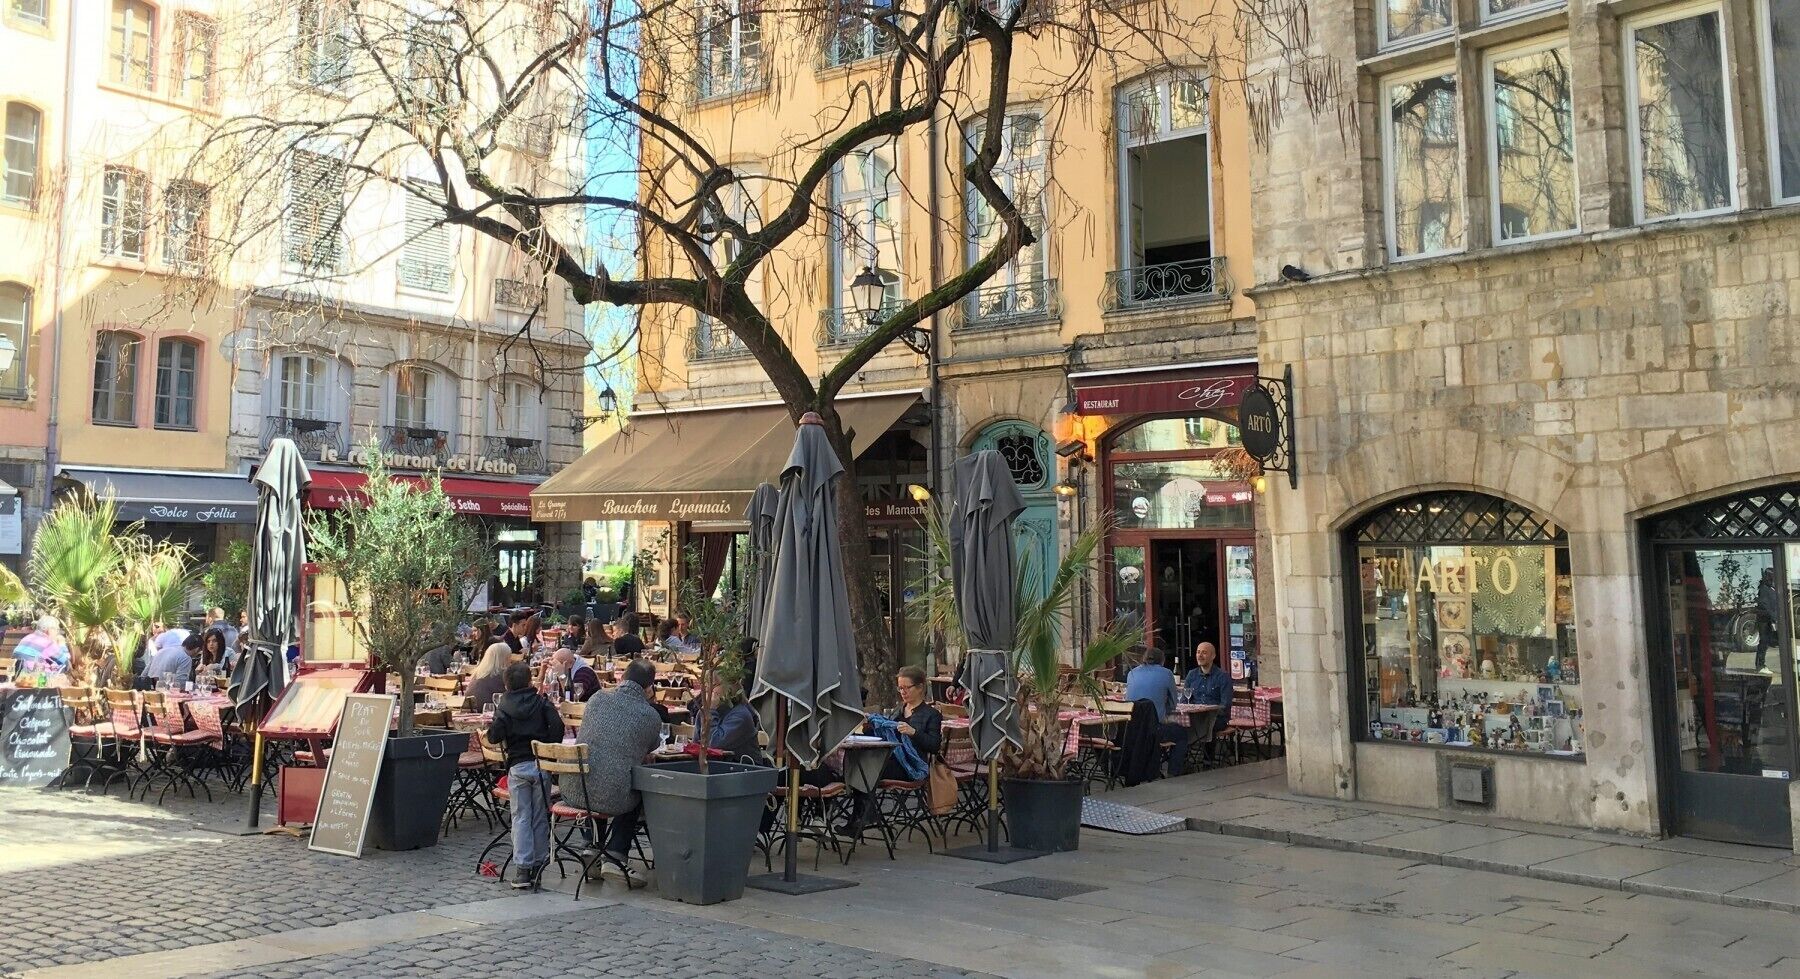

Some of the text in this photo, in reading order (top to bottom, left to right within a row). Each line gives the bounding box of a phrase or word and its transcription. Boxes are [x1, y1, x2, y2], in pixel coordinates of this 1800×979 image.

[1178, 379, 1234, 409] Chez
[1083, 399, 1120, 410] RESTAURANT
[320, 443, 517, 475] le reaurant de Setha
[149, 505, 237, 521] Dolce Follia
[457, 499, 480, 511] Setha
[601, 498, 731, 518] Bouchon Lyonnais
[9, 730, 52, 745] Chocolat
